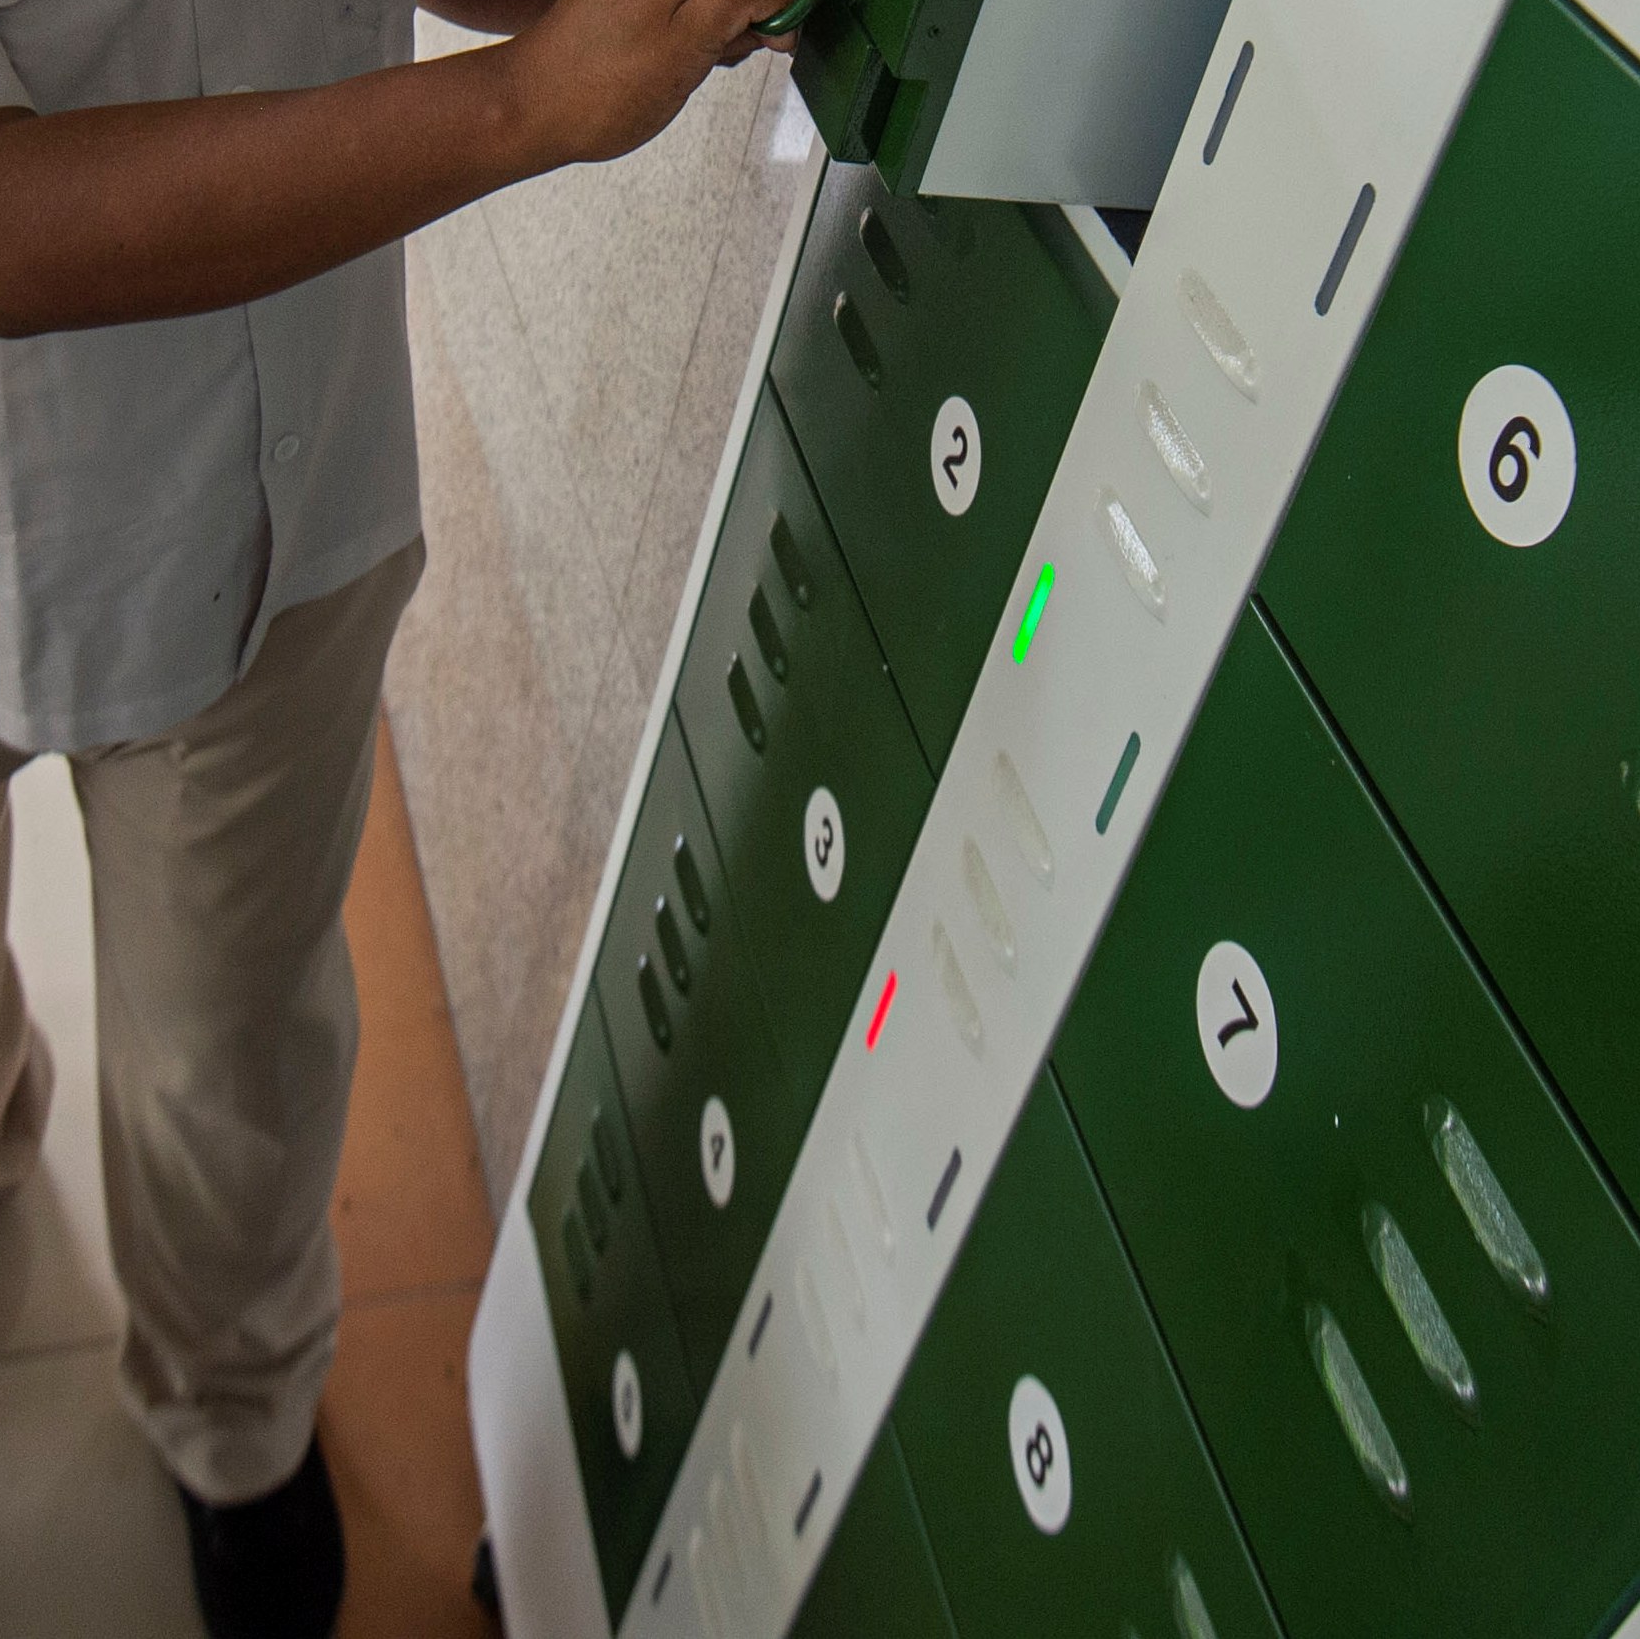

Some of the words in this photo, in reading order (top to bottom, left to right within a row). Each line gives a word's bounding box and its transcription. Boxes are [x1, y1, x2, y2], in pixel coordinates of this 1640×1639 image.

[942, 425, 969, 490] 2
[1488, 415, 1542, 503] 6
[814, 816, 835, 869] 3
[1216, 978, 1260, 1049] 7
[1025, 1423, 1055, 1489] 8
